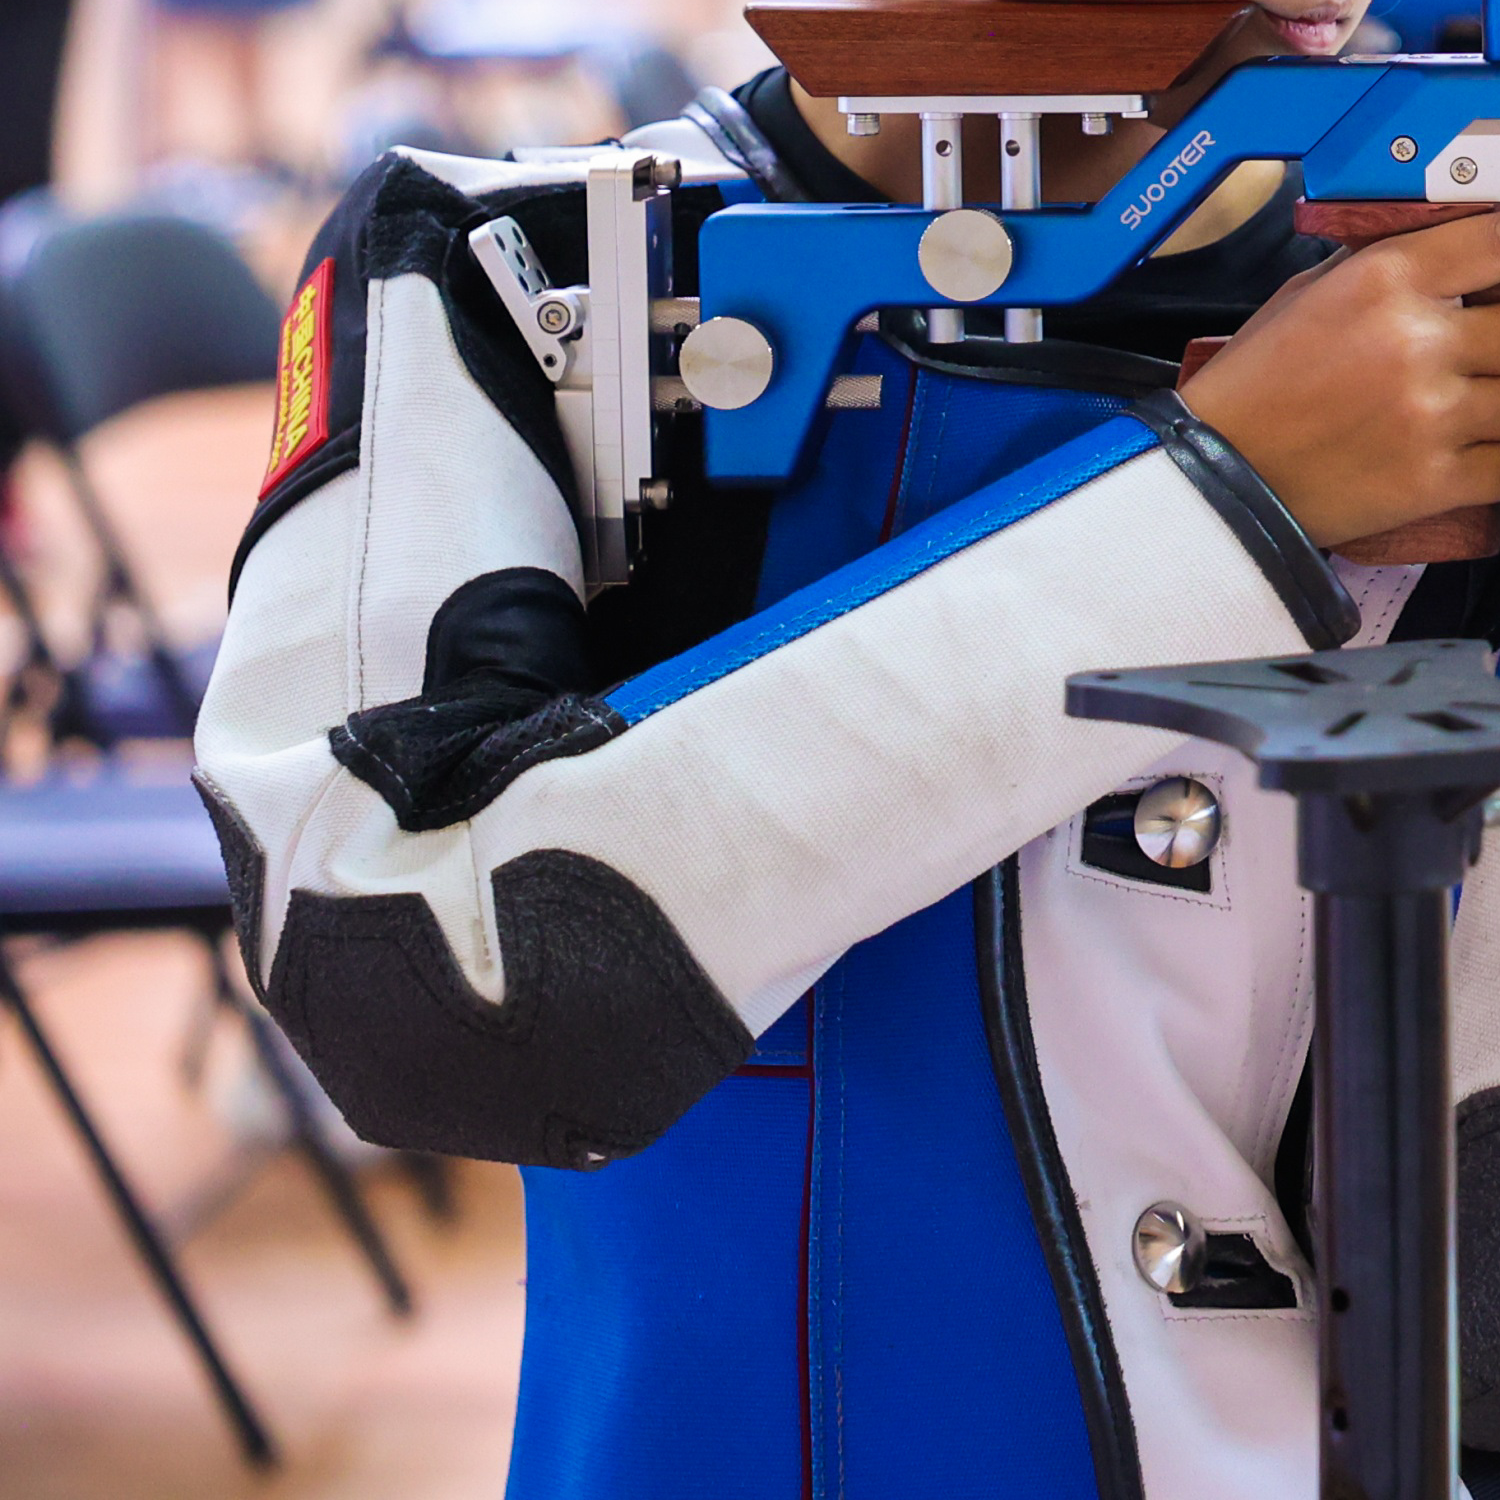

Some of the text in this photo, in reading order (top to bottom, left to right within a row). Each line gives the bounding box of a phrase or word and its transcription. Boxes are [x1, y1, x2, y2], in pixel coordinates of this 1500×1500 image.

[1120, 129, 1217, 231] SUOOTER
[283, 284, 317, 459] 中国 CHINA
